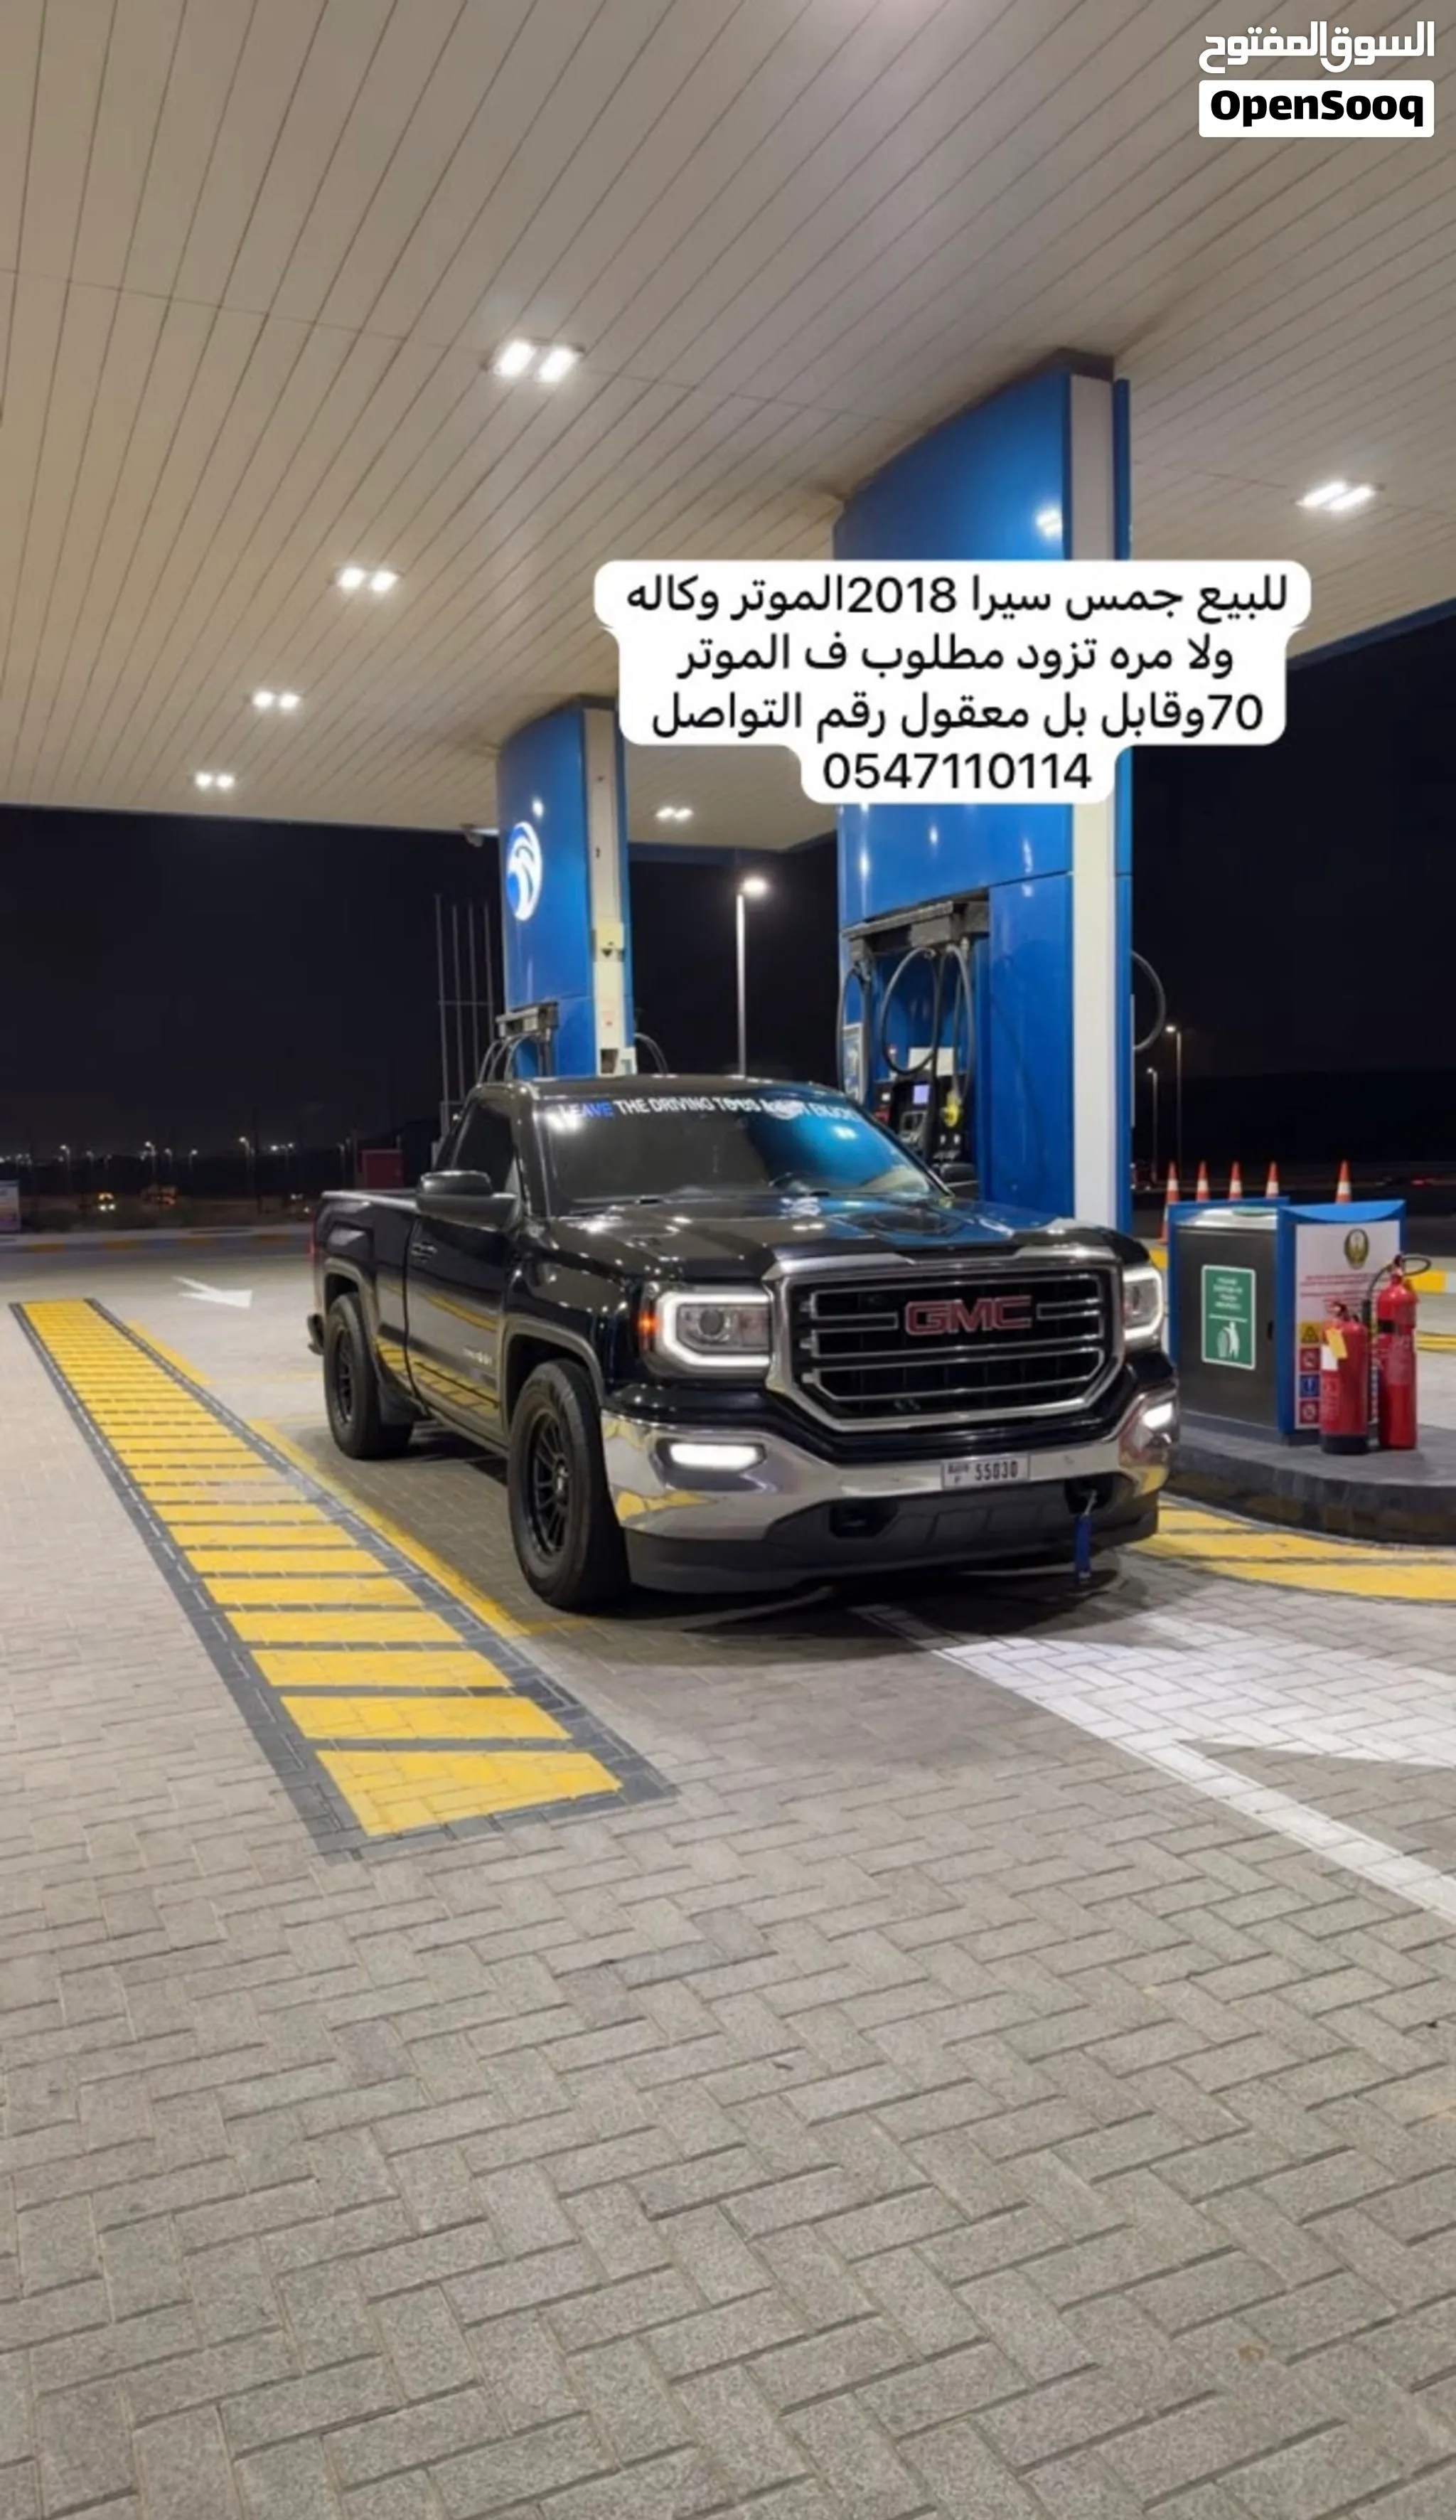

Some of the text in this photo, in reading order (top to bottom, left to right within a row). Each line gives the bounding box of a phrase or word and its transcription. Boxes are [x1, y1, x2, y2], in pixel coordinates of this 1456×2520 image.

[614, 1098, 651, 1115] THE
[648, 1095, 716, 1113] DRIVING
[906, 1296, 1032, 1335] GMC
